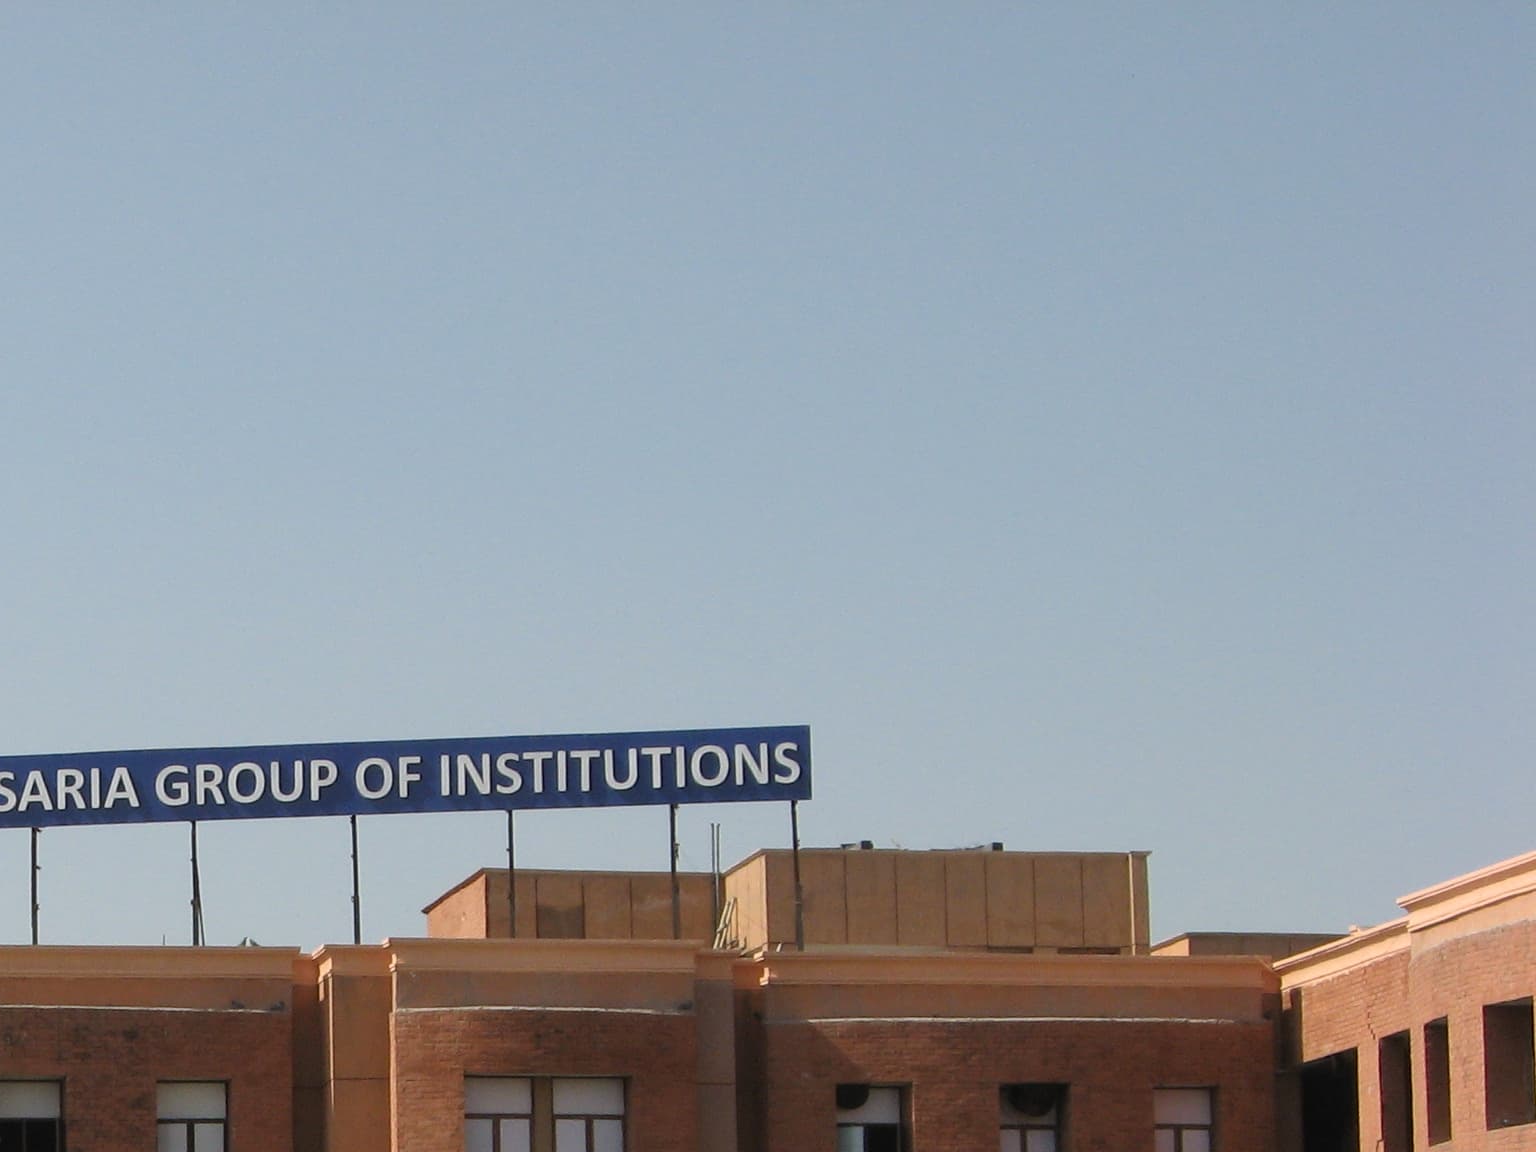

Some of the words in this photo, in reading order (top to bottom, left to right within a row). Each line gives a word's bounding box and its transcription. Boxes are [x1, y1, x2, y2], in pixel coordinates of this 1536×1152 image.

[155, 759, 338, 807] GROUP
[355, 755, 422, 799] OF
[440, 741, 801, 796] INSTITUTIONS
